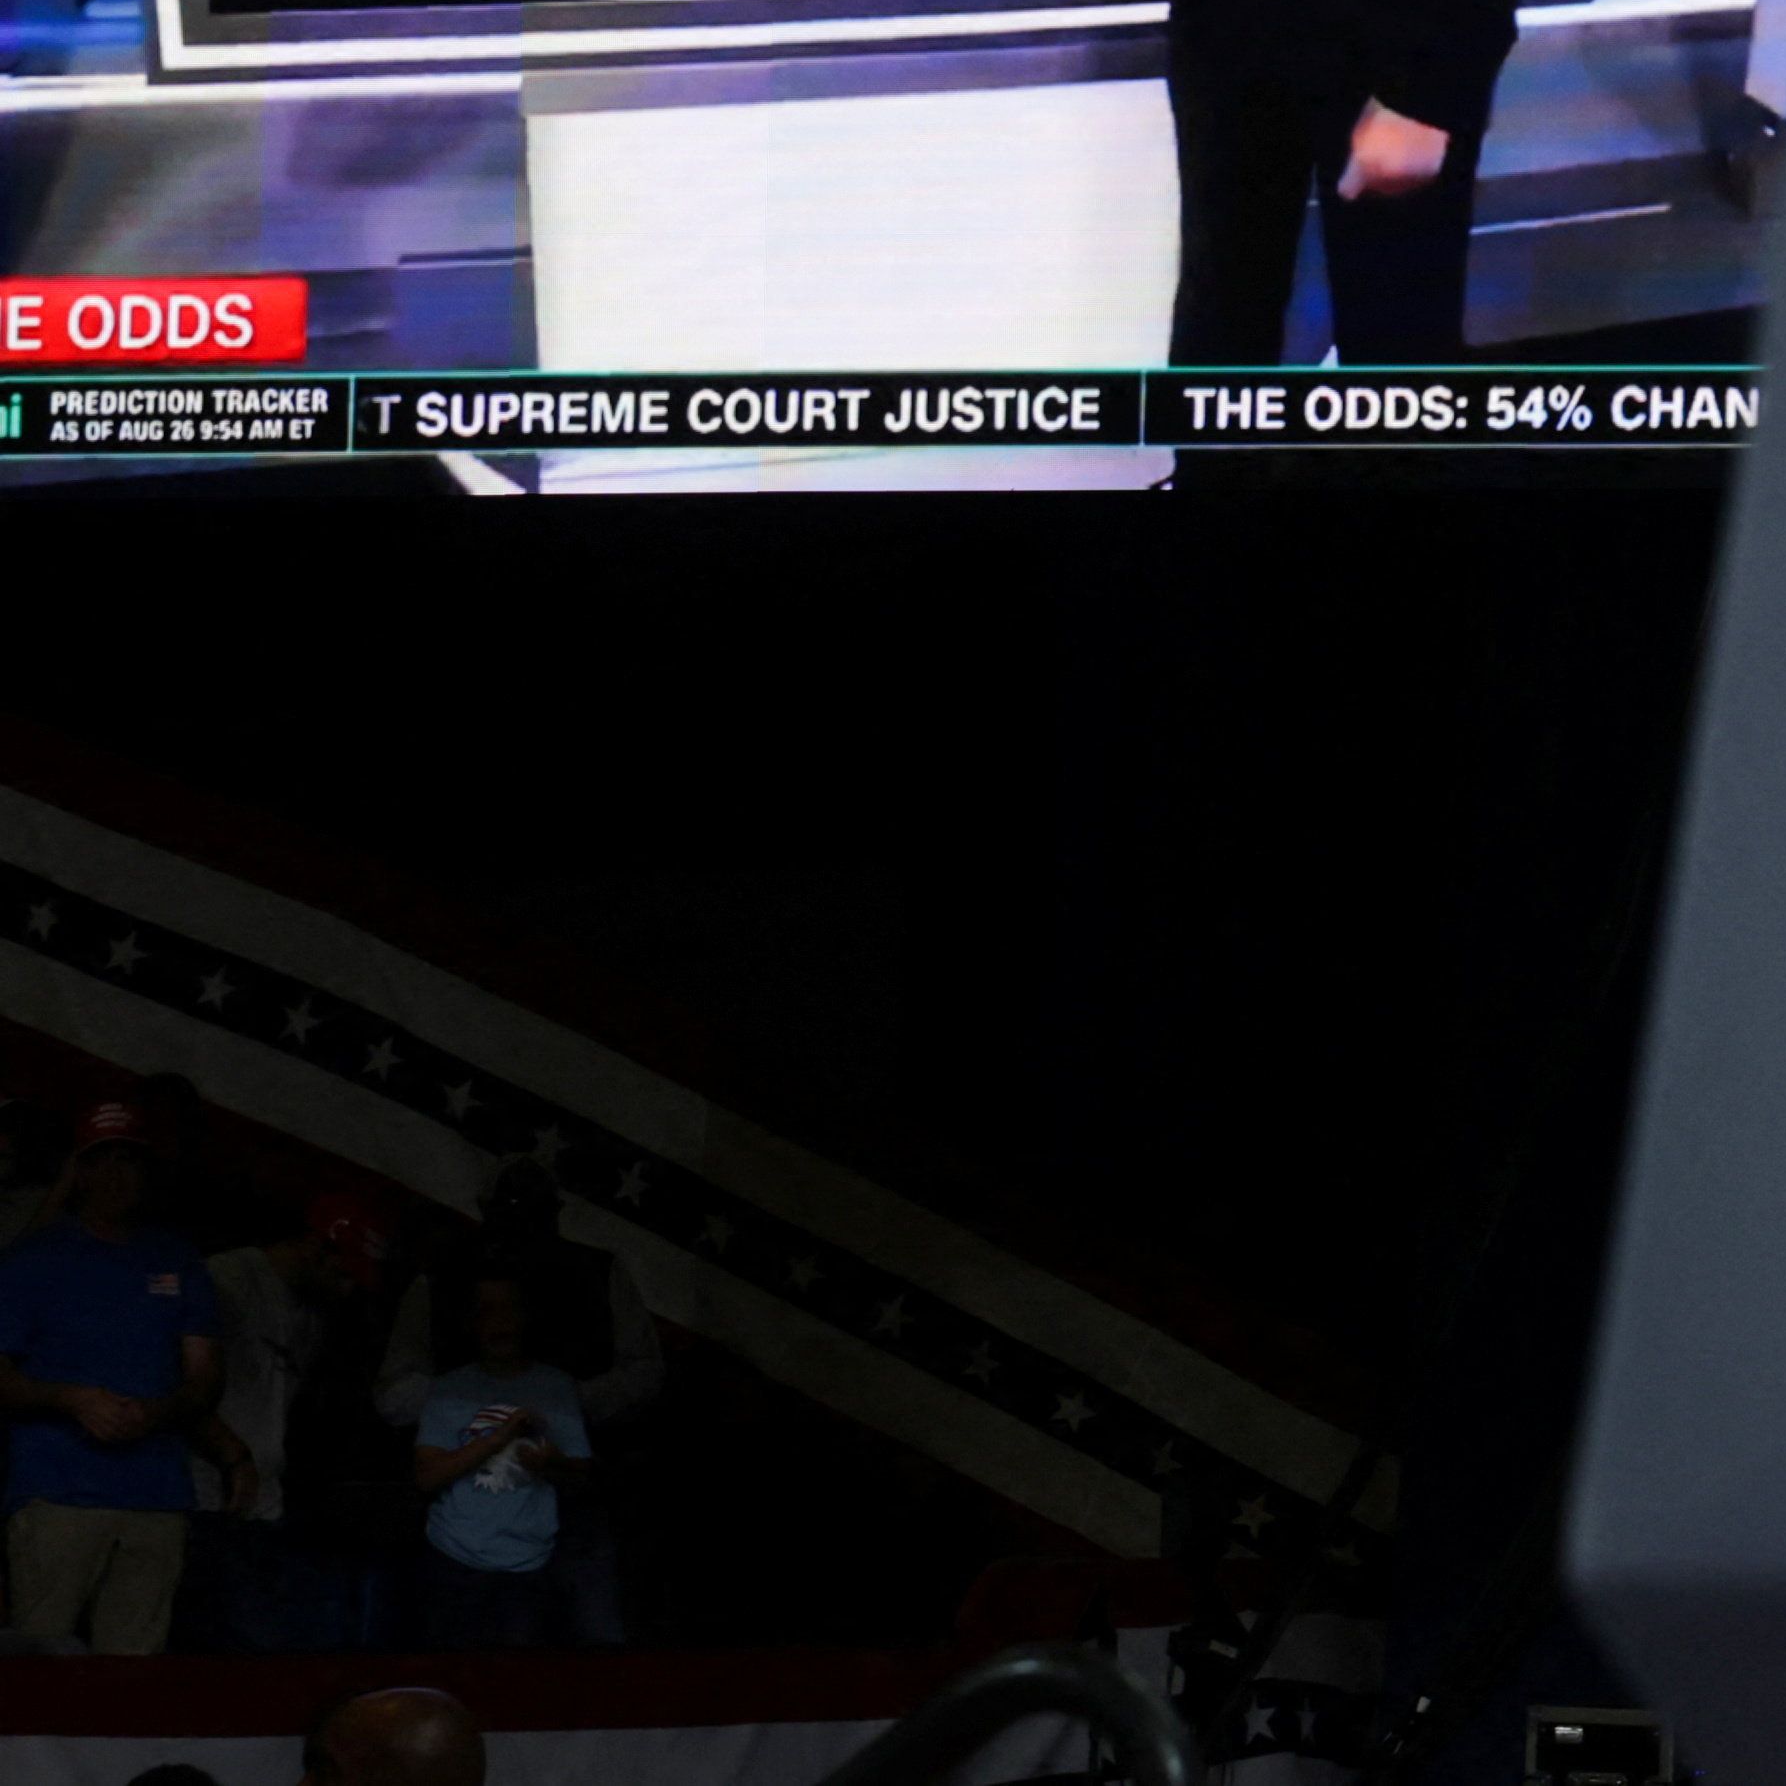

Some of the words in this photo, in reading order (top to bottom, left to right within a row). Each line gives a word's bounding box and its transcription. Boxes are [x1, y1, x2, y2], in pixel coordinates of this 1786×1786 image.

[0, 294, 44, 351] E
[66, 292, 255, 351] ODDS
[50, 388, 205, 417] PREDICTION
[211, 387, 331, 416] TRACKER
[357, 393, 403, 436] T
[414, 389, 672, 439] SUPREME
[687, 387, 872, 435] COURT
[884, 386, 1102, 433] JUSTICE
[1183, 386, 1287, 431] THE
[1303, 385, 1469, 432] ODDS:
[1485, 385, 1593, 432] 54%
[50, 420, 81, 443] AS
[84, 420, 115, 442] OF
[119, 419, 166, 442] AUG
[169, 419, 196, 442] 26
[199, 419, 245, 441] 9:54
[248, 418, 285, 441] AM
[288, 418, 317, 440] ET
